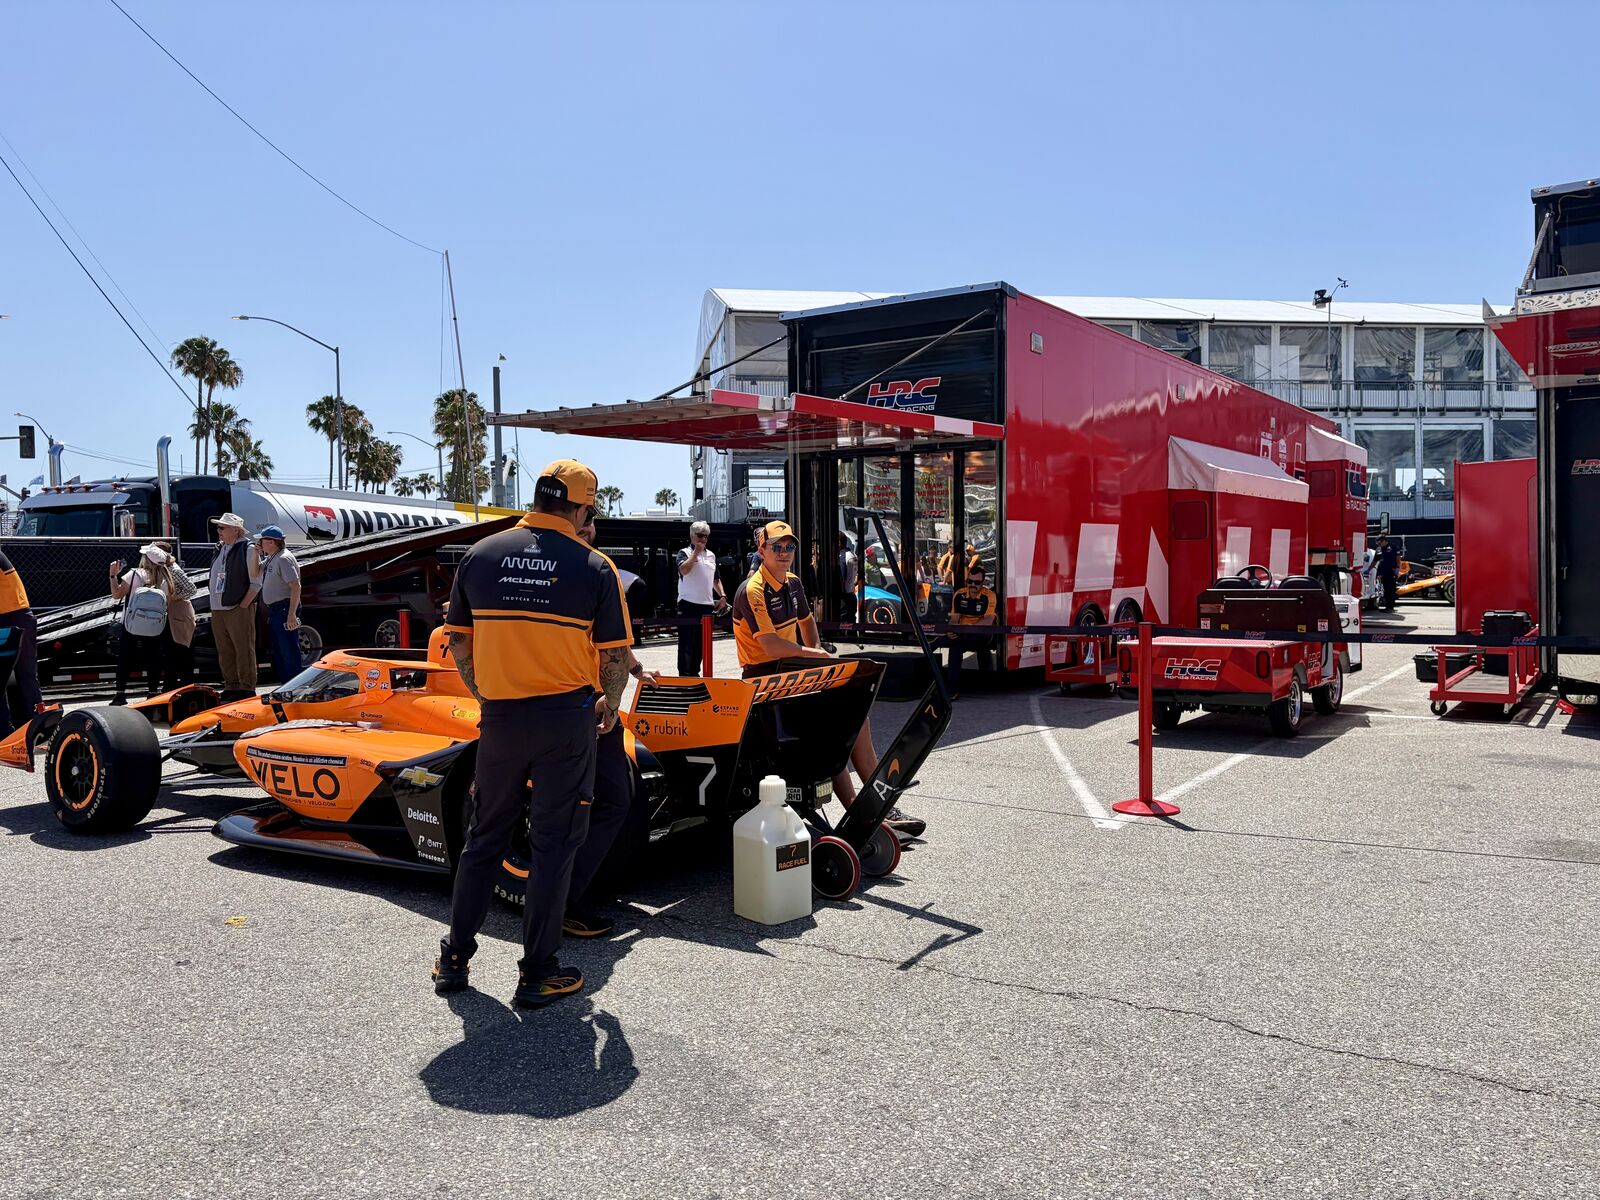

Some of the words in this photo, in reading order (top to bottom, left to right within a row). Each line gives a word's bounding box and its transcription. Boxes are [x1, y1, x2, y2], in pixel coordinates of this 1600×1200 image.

[866, 377, 942, 408] HRC
[1571, 459, 1600, 472] HR
[339, 508, 461, 538] INDY
[501, 556, 557, 572] ARROW
[498, 576, 551, 587] McLaren
[1165, 658, 1221, 676] HRC
[654, 720, 688, 736] rubrik
[250, 759, 341, 801] VELO
[685, 756, 717, 806] 7
[407, 807, 440, 825] Deloitte.
[790, 845, 796, 857] 7
[778, 861, 794, 870] RACE
[794, 858, 807, 866] FUEL
